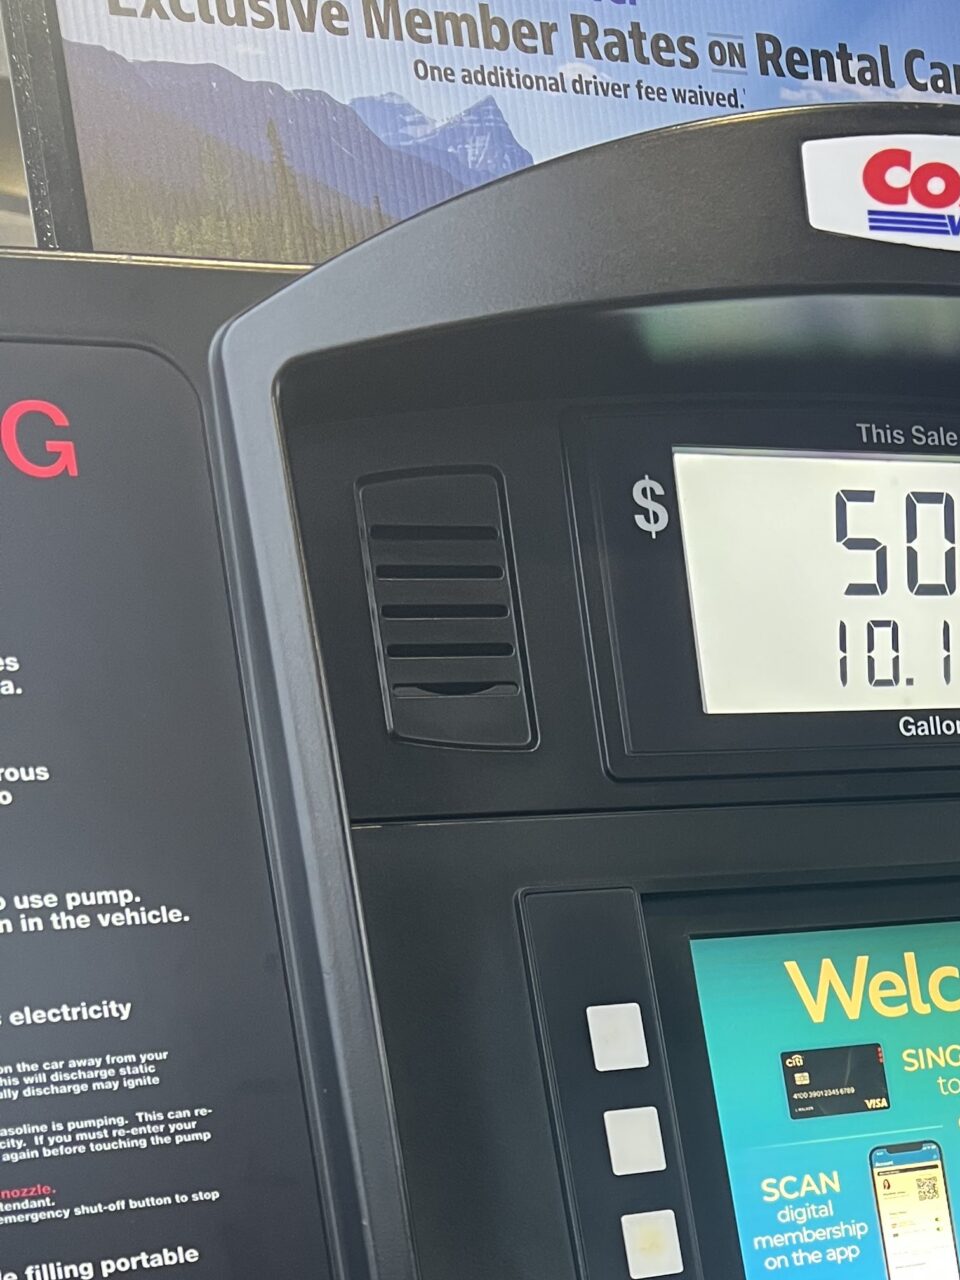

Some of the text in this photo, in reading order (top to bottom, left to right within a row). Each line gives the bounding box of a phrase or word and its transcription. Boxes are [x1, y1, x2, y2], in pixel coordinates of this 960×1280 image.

[363, 0, 558, 56] Member
[570, 14, 700, 69] Rates
[708, 40, 746, 69] ON
[756, 33, 896, 89] Rental
[413, 59, 668, 104] One additional driver fee
[856, 423, 958, 447] This Sale
[632, 475, 669, 538] $
[14, 888, 141, 909] use pump.
[20, 905, 190, 932] in the vehicle.
[10, 999, 132, 1027] electricity
[51, 1062, 155, 1082] discharge static
[864, 1098, 888, 1108] VISA
[761, 1171, 841, 1201] SCAN
[74, 1196, 172, 1216] shut-off button
[777, 1200, 834, 1224] digital
[752, 1219, 868, 1250] membership
[101, 1245, 199, 1277] portable
[764, 1244, 860, 1270] on the app
